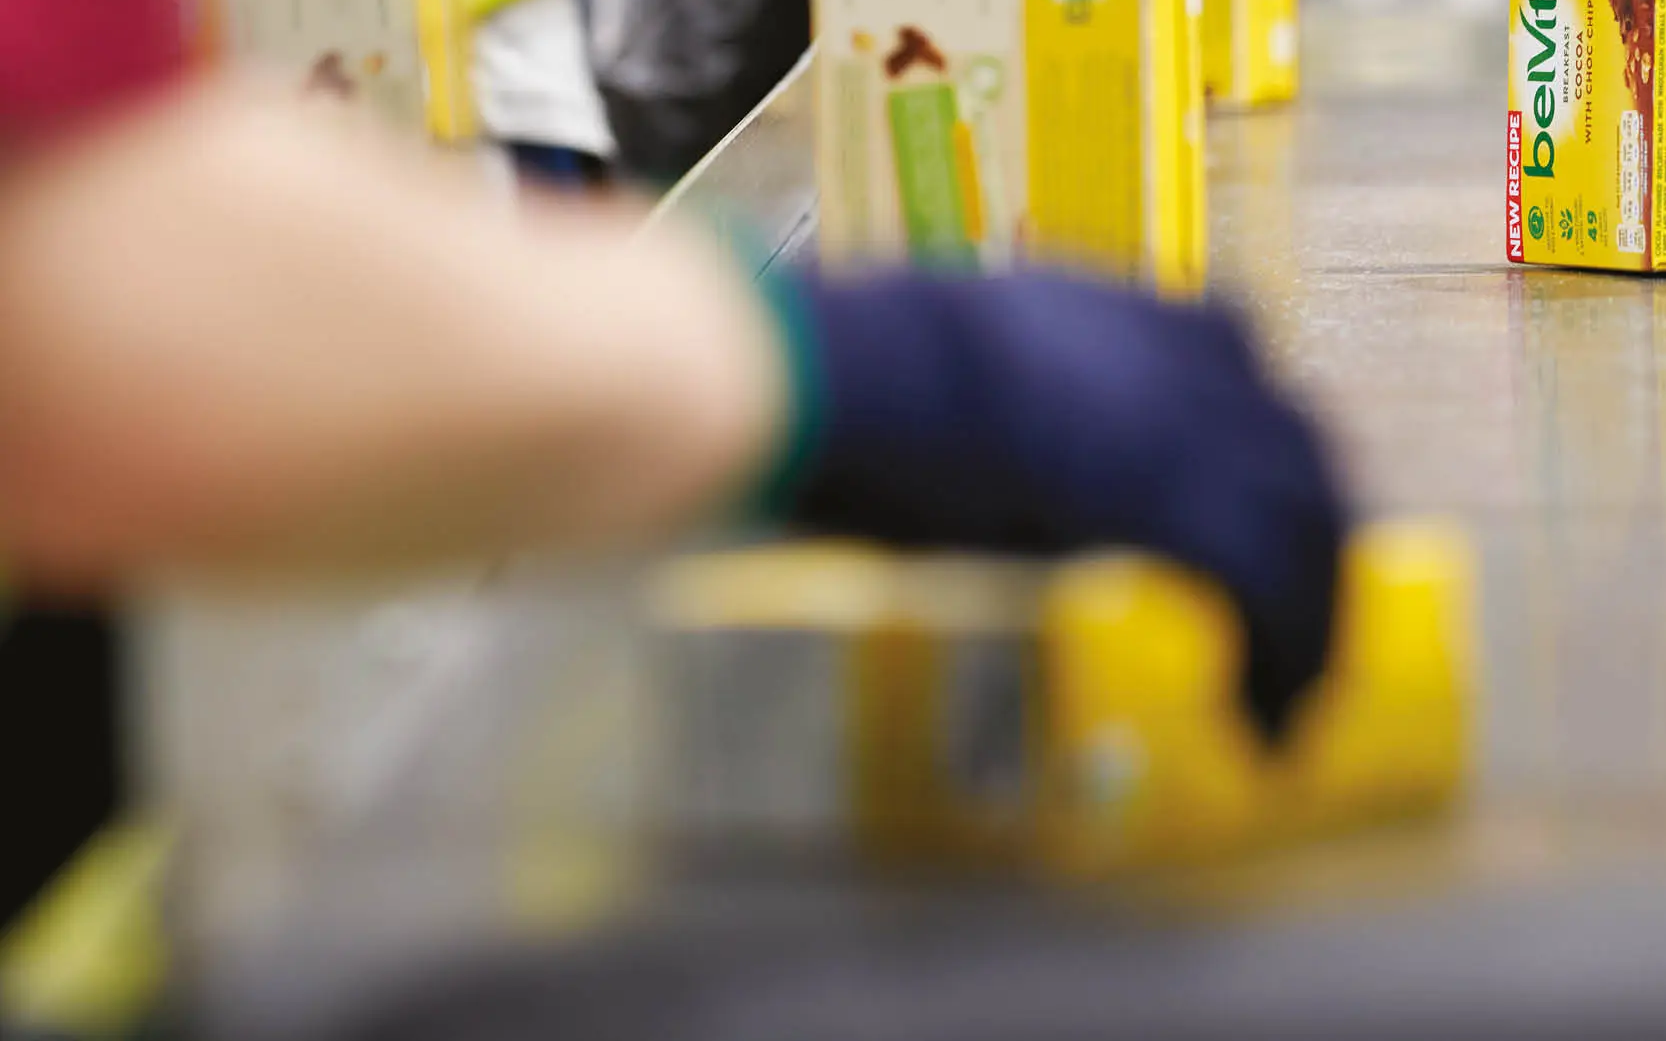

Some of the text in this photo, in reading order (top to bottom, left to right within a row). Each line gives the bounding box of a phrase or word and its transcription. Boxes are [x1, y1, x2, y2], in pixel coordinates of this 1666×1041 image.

[1563, 25, 1571, 103] BREAKFAST
[1575, 31, 1583, 100] COCOA
[1586, 45, 1594, 95] CHOC
[1585, 101, 1593, 144] WITH
[1509, 114, 1522, 257] NEW RECIPE
[1587, 210, 1598, 242] 49
